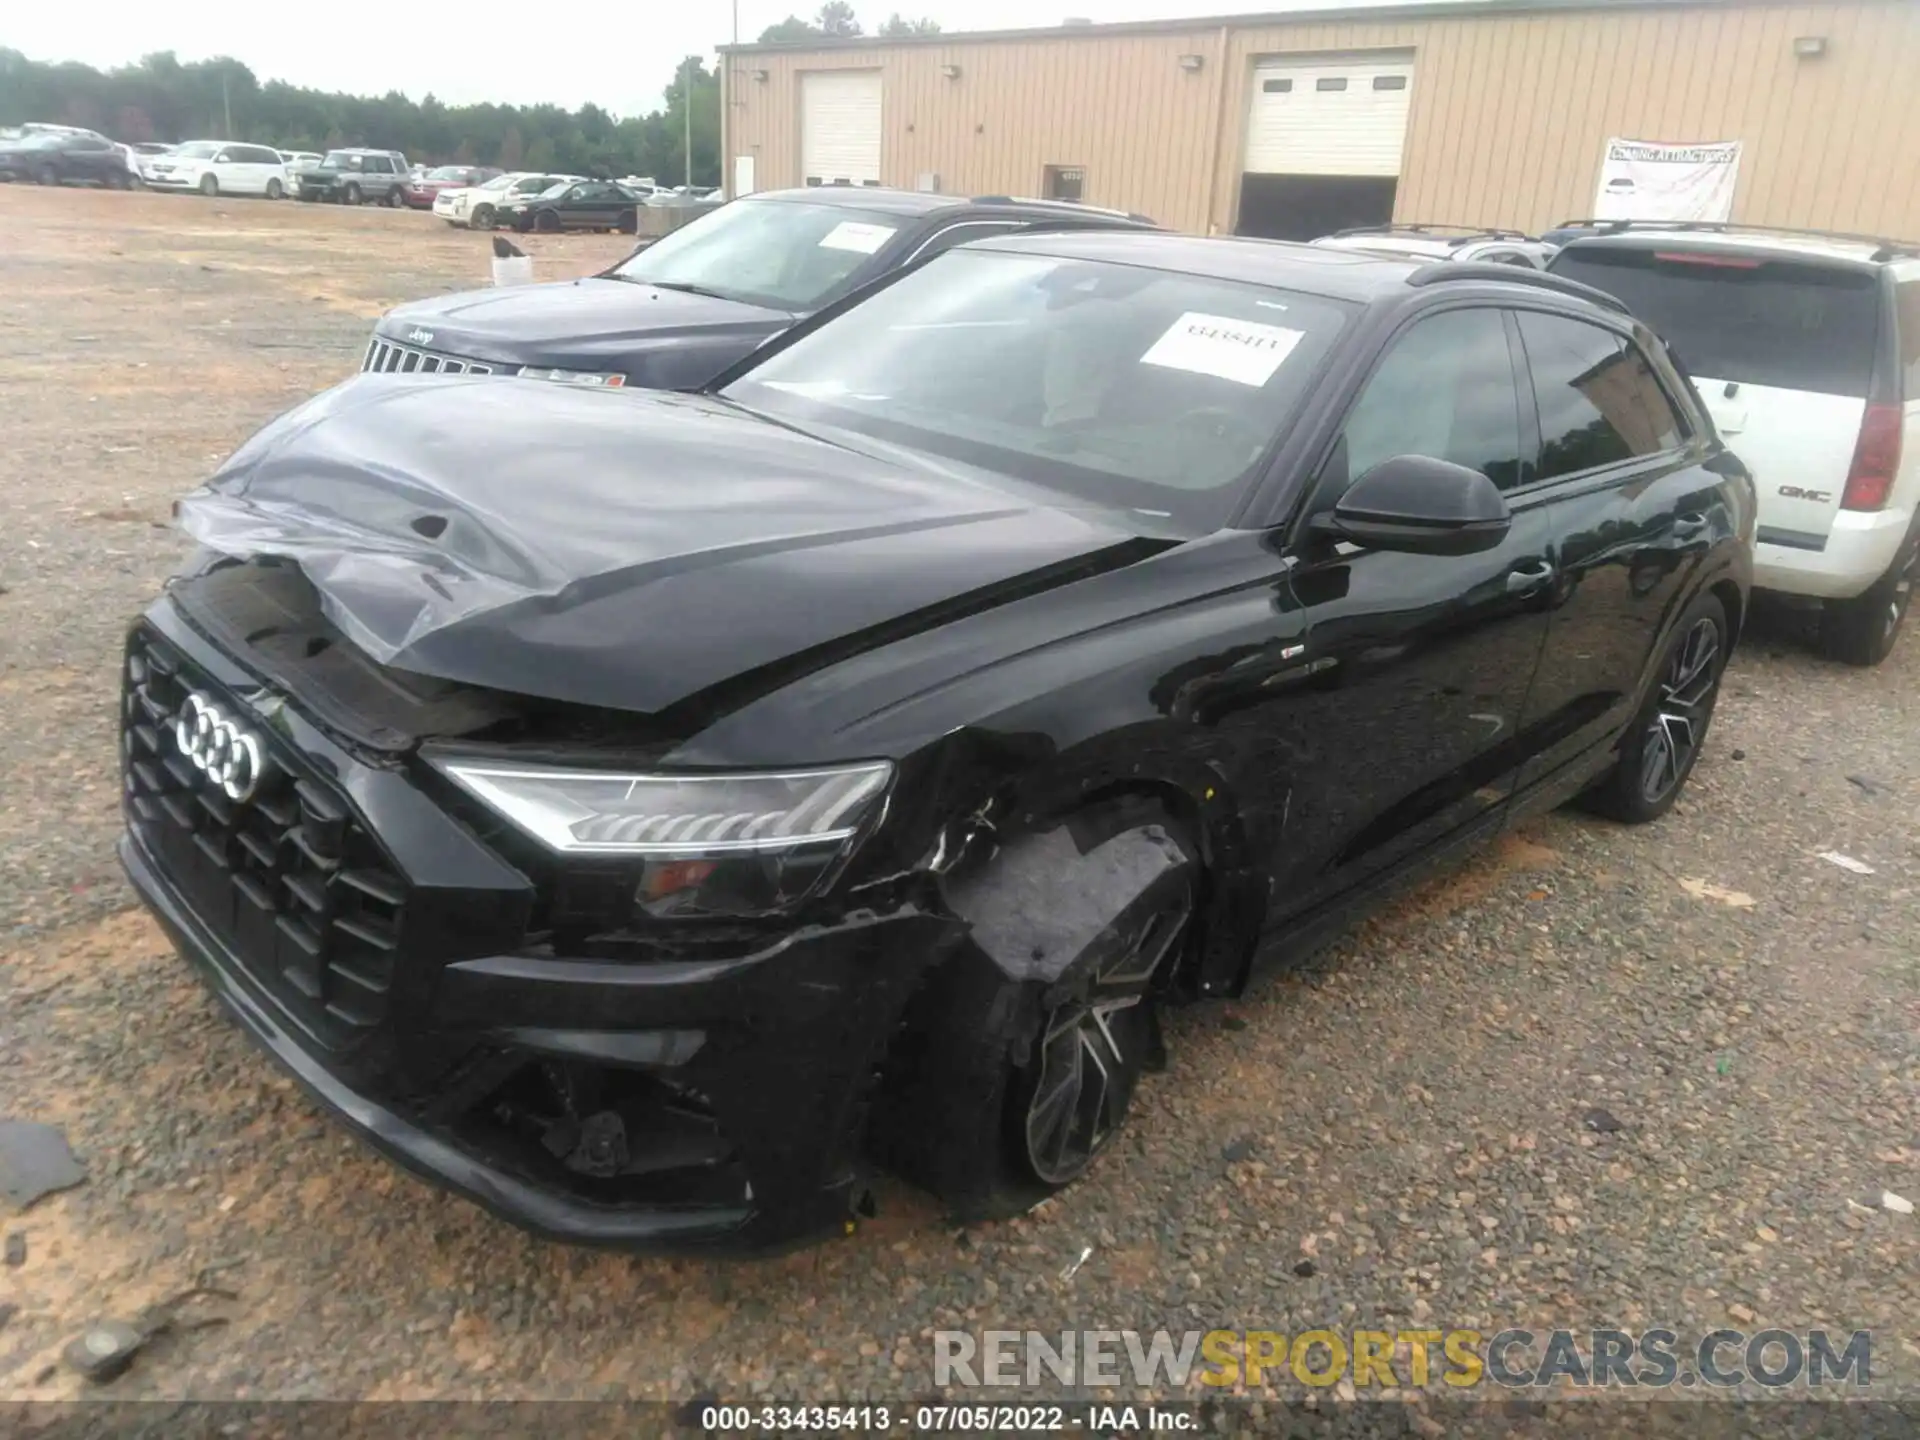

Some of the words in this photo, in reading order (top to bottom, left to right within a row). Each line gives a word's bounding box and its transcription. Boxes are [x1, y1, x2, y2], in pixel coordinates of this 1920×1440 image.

[1611, 147, 1655, 161] COMING
[1656, 149, 1735, 163] ATTRACTIONS
[409, 326, 434, 345] Jeep
[1778, 485, 1832, 503] GMC
